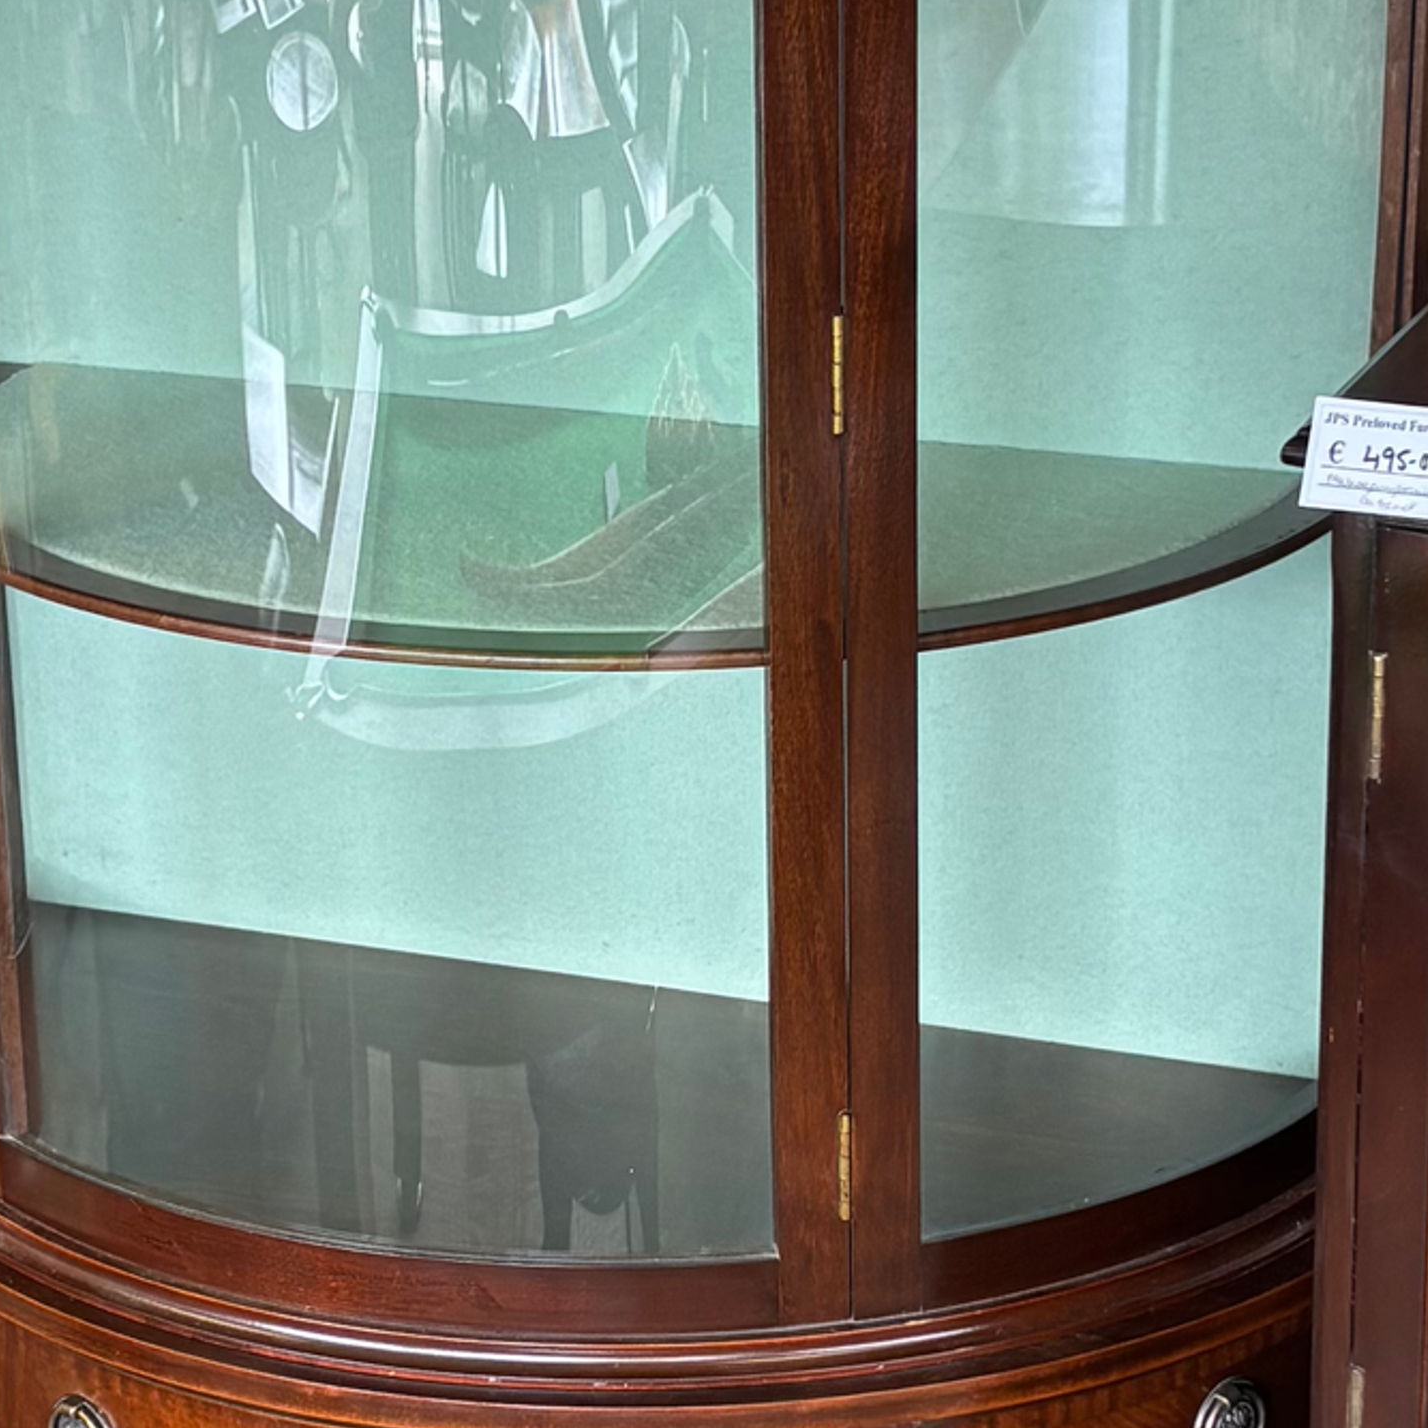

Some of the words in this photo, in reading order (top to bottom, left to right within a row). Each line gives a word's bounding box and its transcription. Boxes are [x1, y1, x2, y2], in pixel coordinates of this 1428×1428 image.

[1324, 412, 1349, 426] JPS
[1352, 414, 1407, 432] Preloved
[1328, 439, 1347, 465] €
